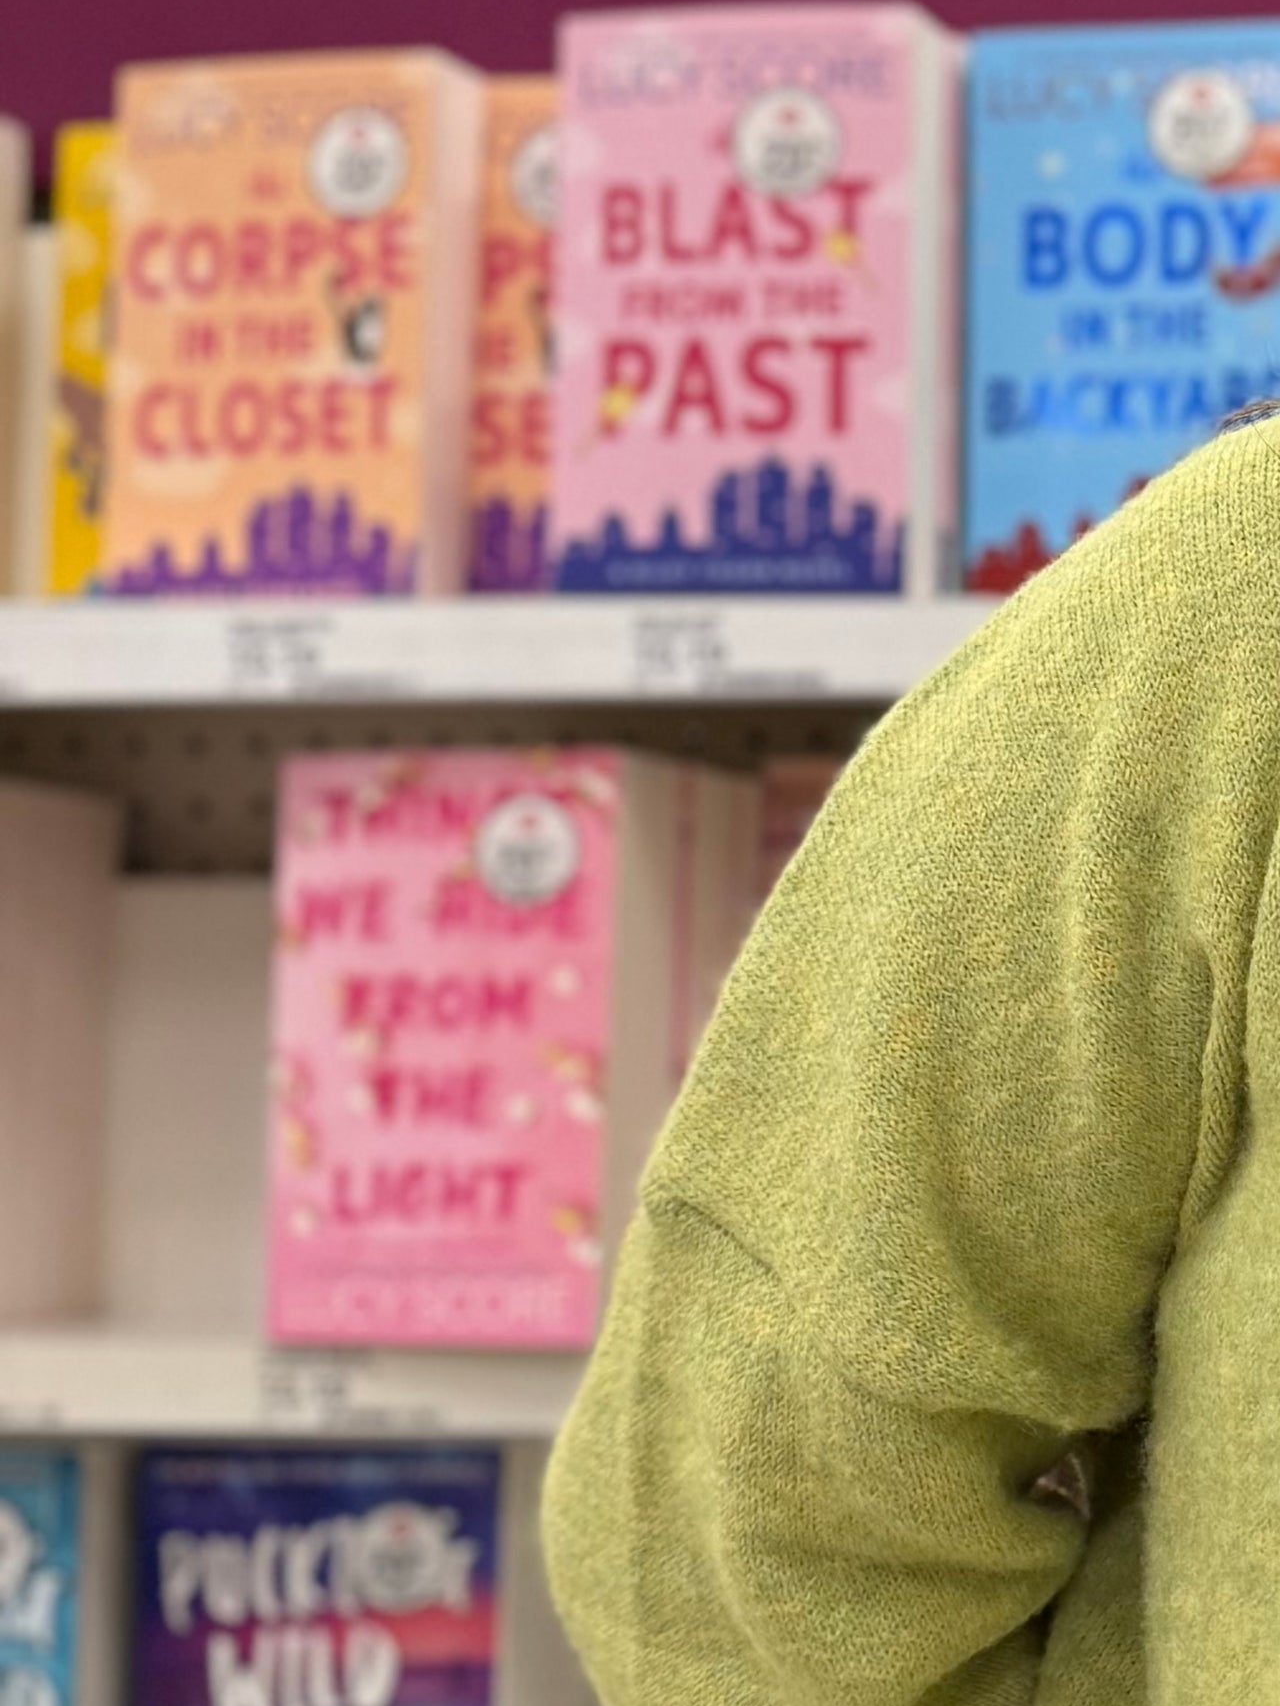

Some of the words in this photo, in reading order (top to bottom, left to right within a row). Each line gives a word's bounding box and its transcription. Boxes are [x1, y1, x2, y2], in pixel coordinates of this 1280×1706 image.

[125, 213, 412, 301] CORPSE
[600, 178, 870, 263] BLAST
[1018, 195, 1272, 289] BODY
[132, 381, 398, 461] CLOSET
[602, 335, 868, 441] PAST
[340, 977, 532, 1029] FROM
